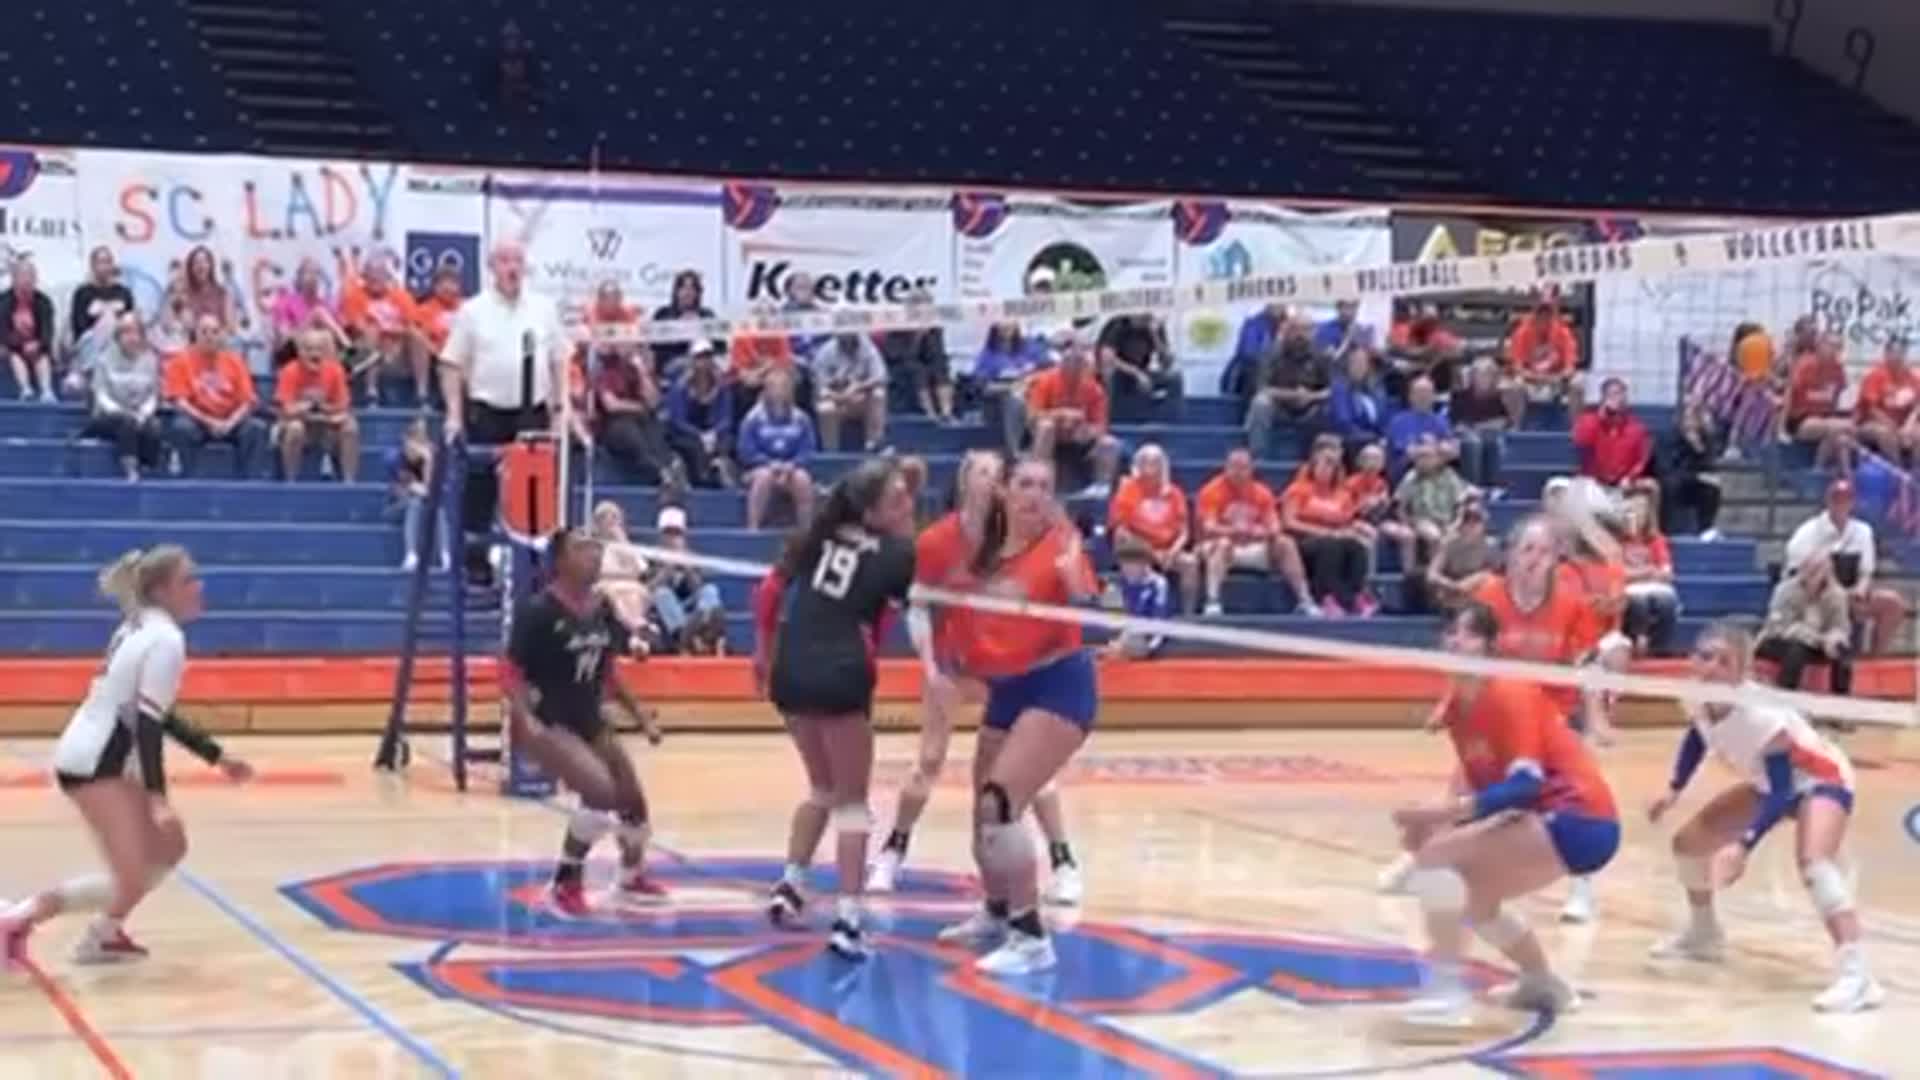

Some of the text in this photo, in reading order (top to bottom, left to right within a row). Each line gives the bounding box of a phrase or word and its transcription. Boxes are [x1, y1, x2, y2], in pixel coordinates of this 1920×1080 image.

[115, 165, 398, 243] SC LADY
[1356, 263, 1461, 296] VOLLEYBALL
[1534, 246, 1633, 278] DRAGONS
[1724, 222, 1876, 261] VOLLEYBALL
[811, 539, 859, 599] 19
